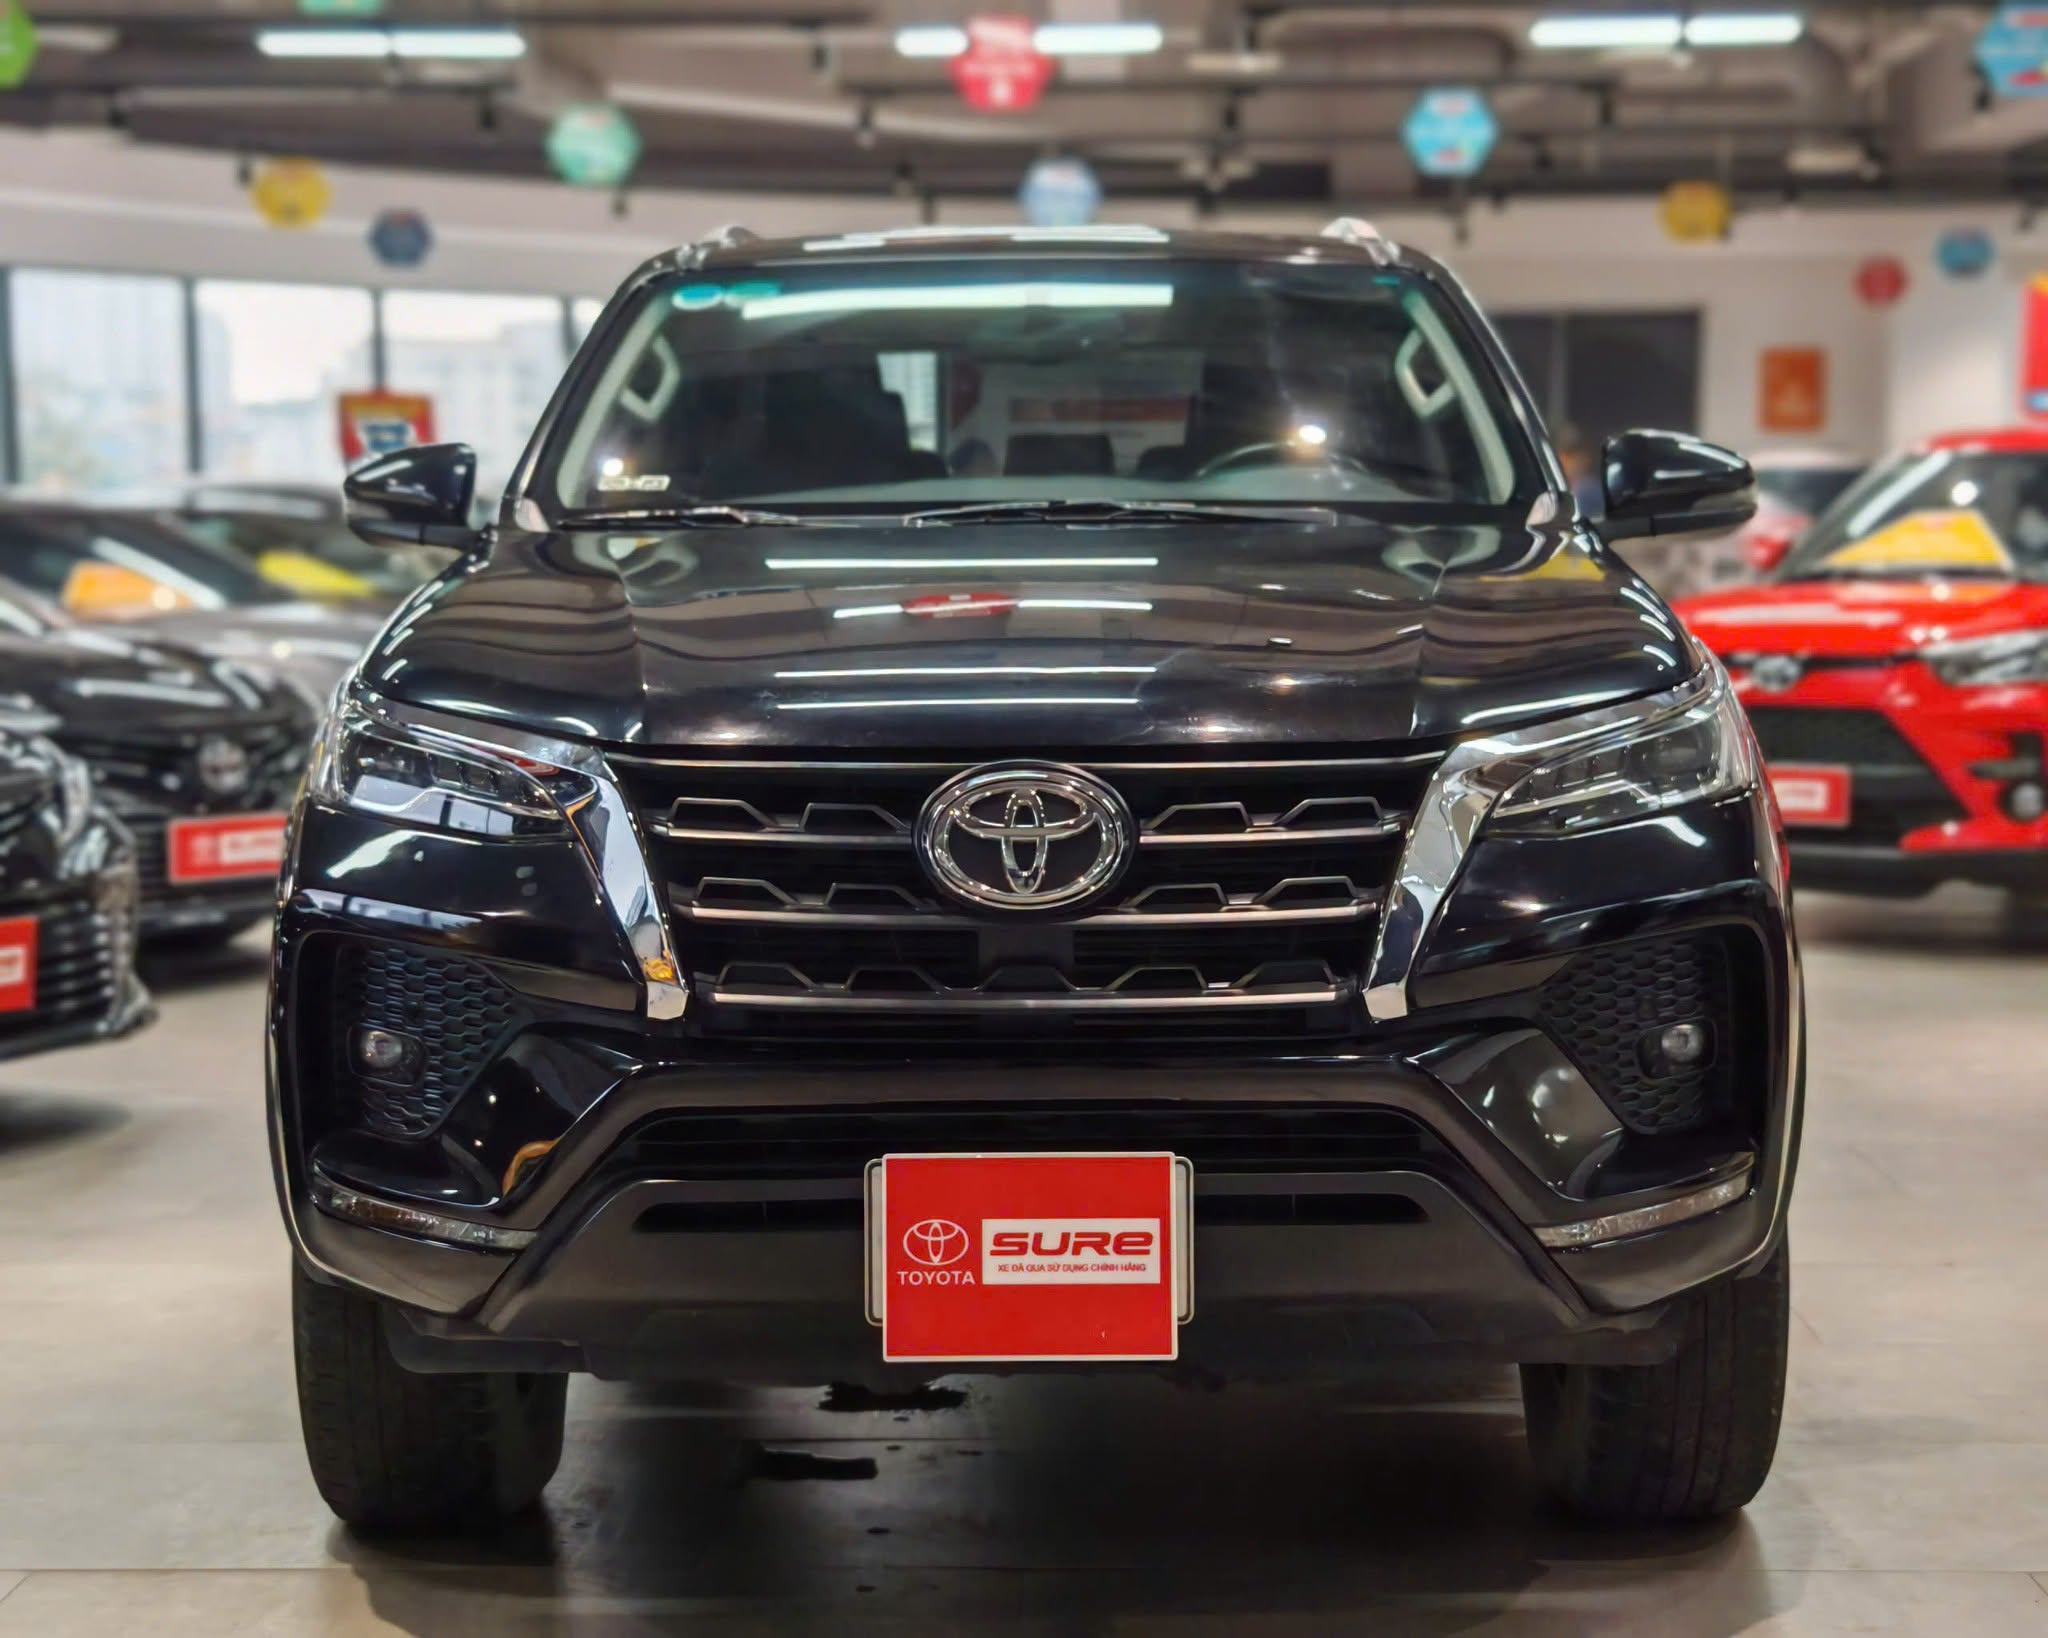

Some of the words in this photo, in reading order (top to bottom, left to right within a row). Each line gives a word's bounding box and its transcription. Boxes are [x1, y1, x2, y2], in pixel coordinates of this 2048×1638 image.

[998, 1264, 1009, 1272] XE
[1026, 1264, 1046, 1272] QUA
[896, 1271, 976, 1285] TOYOTA
